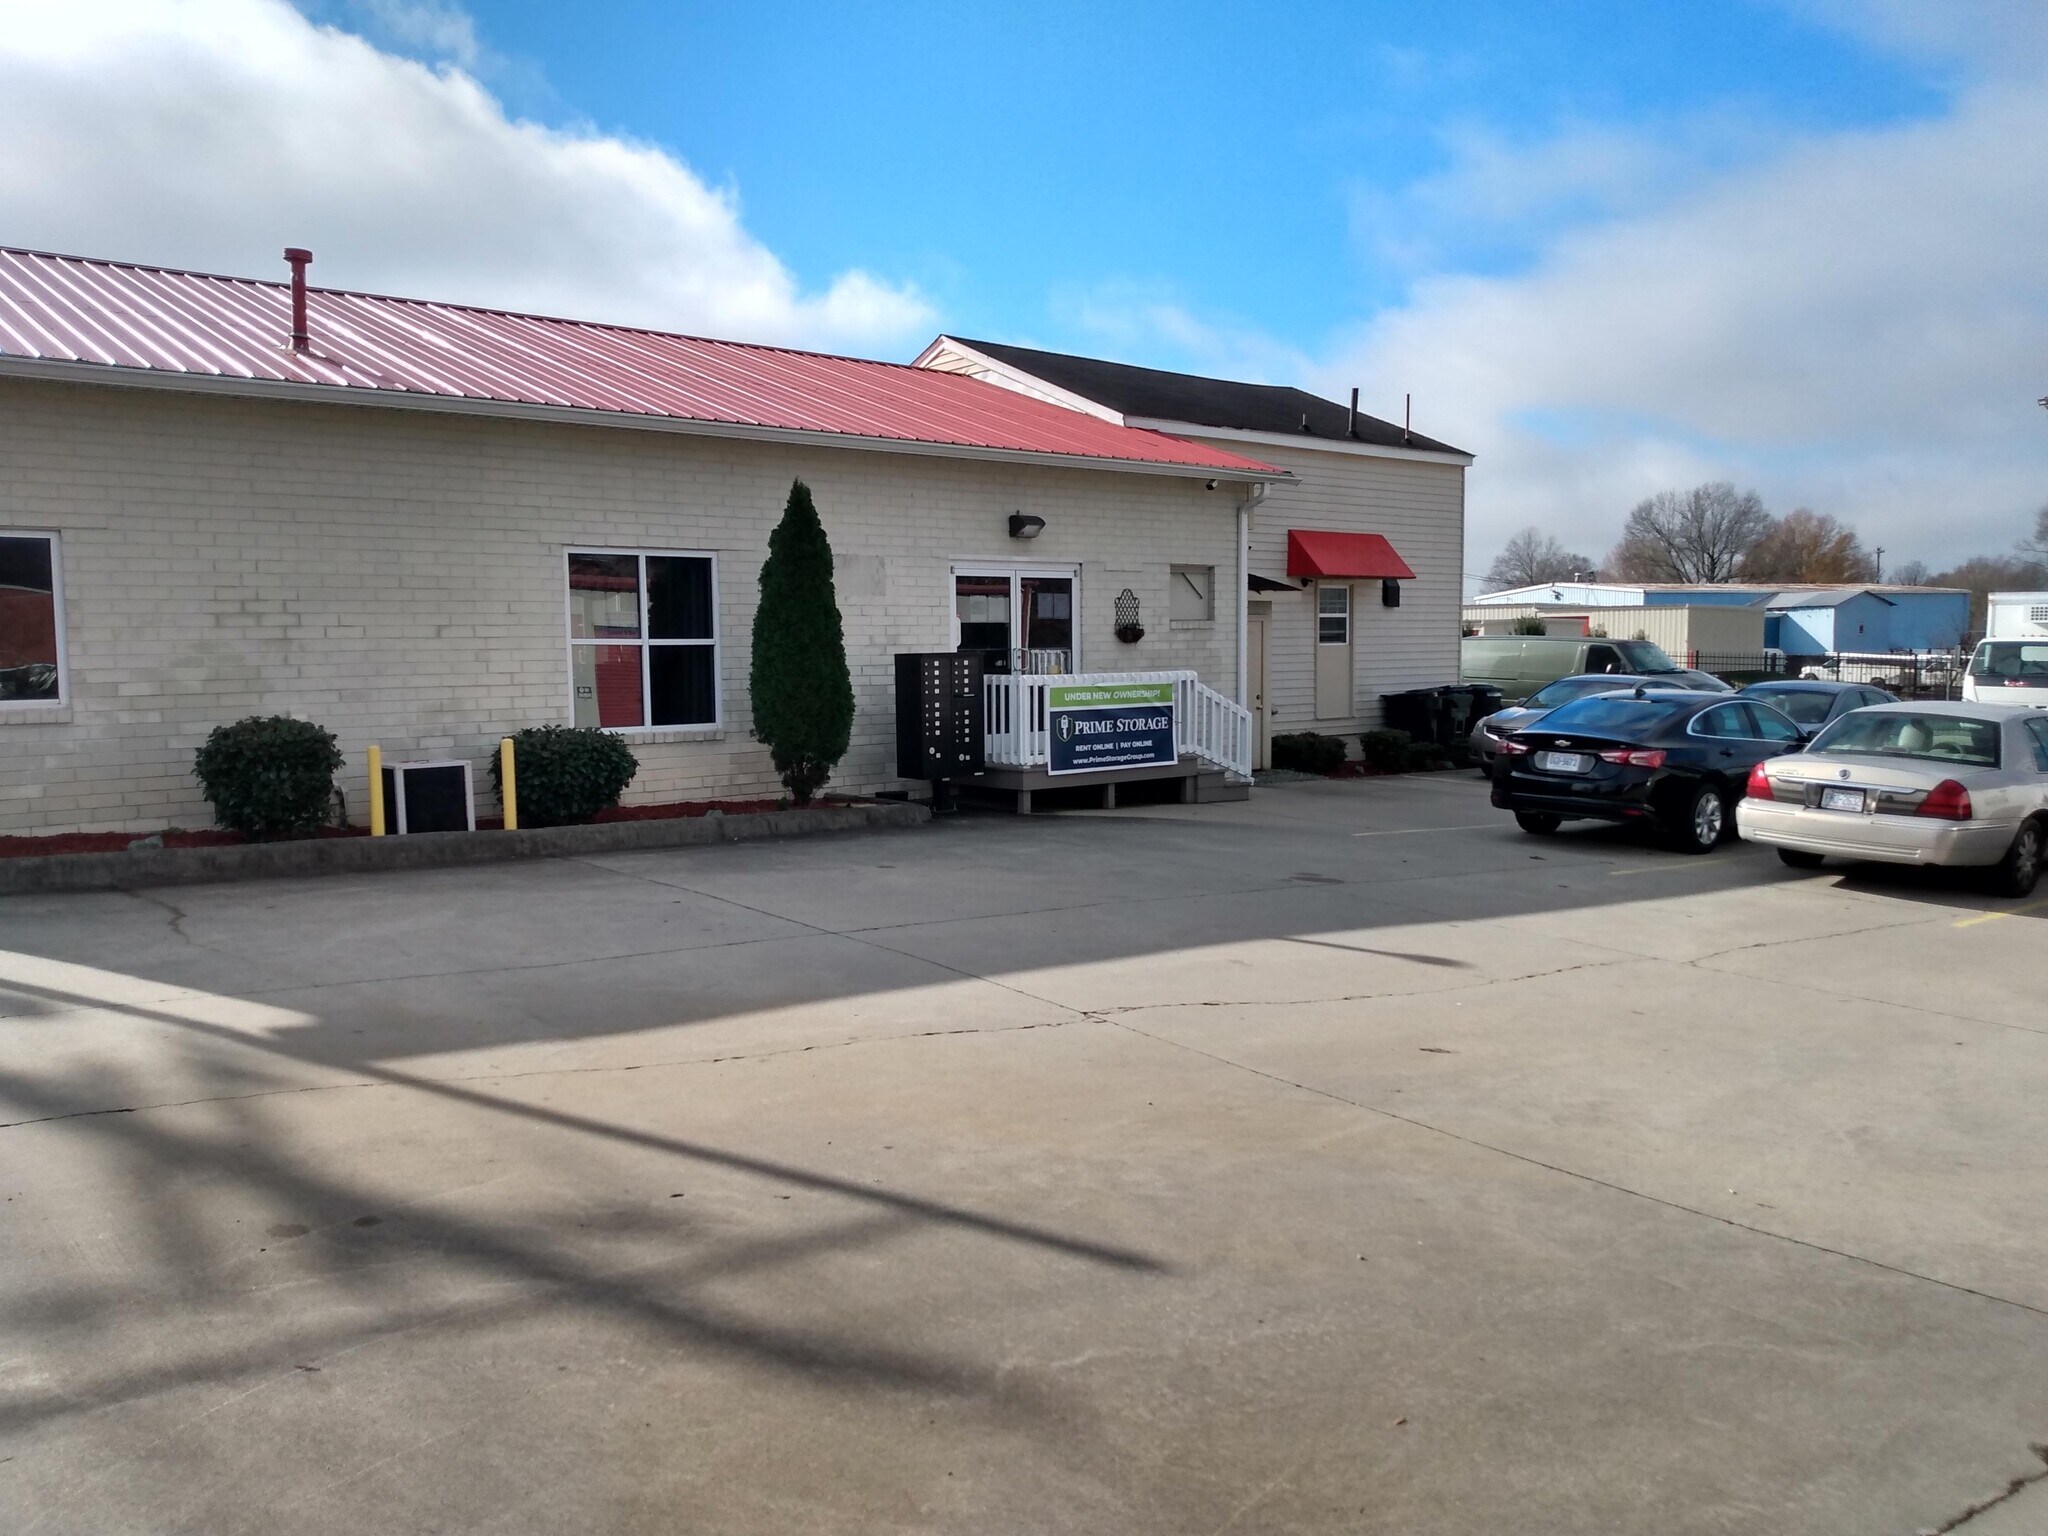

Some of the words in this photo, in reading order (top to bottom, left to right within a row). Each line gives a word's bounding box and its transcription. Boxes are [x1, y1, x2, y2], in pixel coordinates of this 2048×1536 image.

[1064, 692, 1092, 701] UNDER
[1093, 691, 1112, 700] NEW
[1113, 689, 1161, 699] OWNERSHIP!
[1074, 720, 1114, 735] PRIME
[1116, 717, 1169, 732] STORAGE
[1075, 744, 1092, 752] RENT
[1092, 742, 1114, 751] ONLINE
[1132, 740, 1153, 748] ONLINE
[1073, 753, 1155, 765] www.PrimeStorageGroup.com
